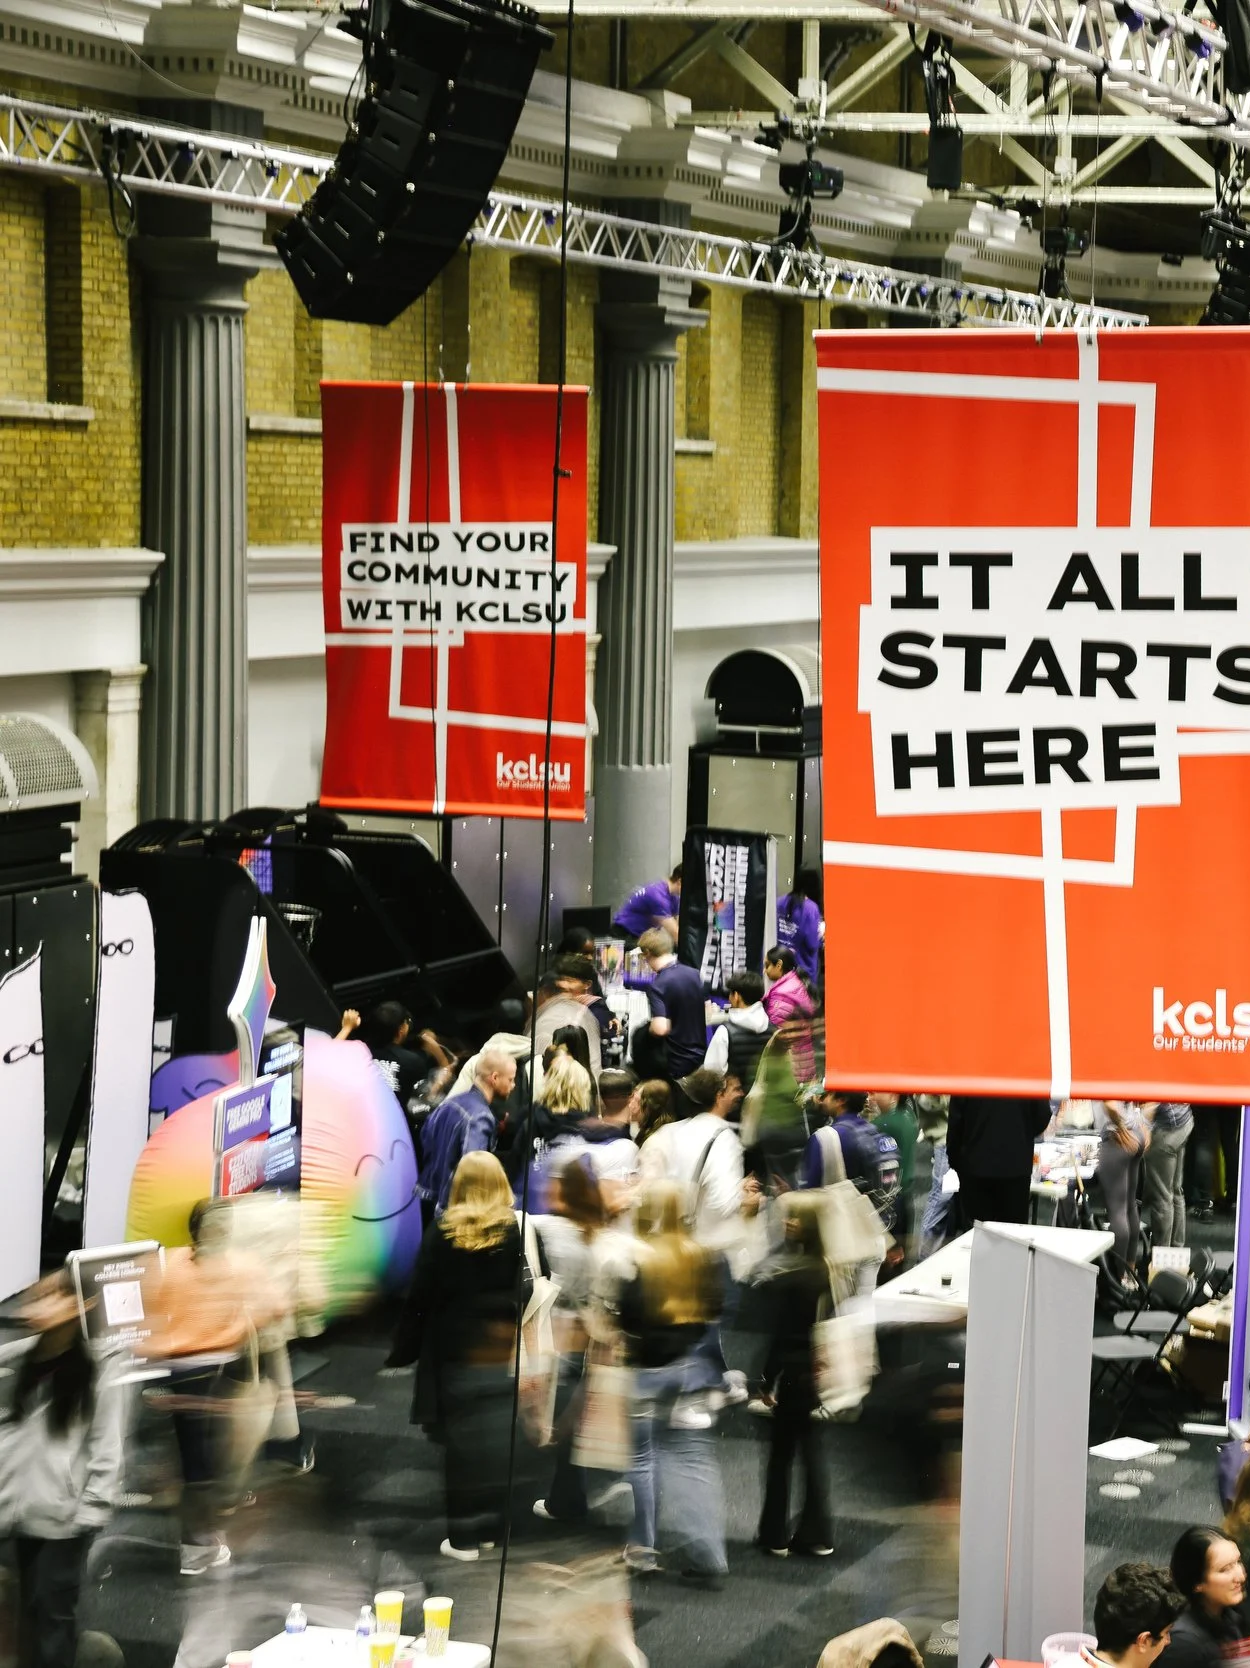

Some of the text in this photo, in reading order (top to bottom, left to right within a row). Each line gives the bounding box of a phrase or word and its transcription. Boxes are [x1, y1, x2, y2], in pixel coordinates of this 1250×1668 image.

[350, 531, 550, 553] FIND YOUR
[347, 560, 570, 592] COMMUNITY
[889, 551, 1238, 611] IT ALL
[347, 598, 567, 624] WITH KCLSU
[496, 752, 571, 782] kclsu
[891, 722, 1160, 790] HERE
[1153, 1034, 1179, 1051] Our
[1182, 1035, 1248, 1053] Students'
